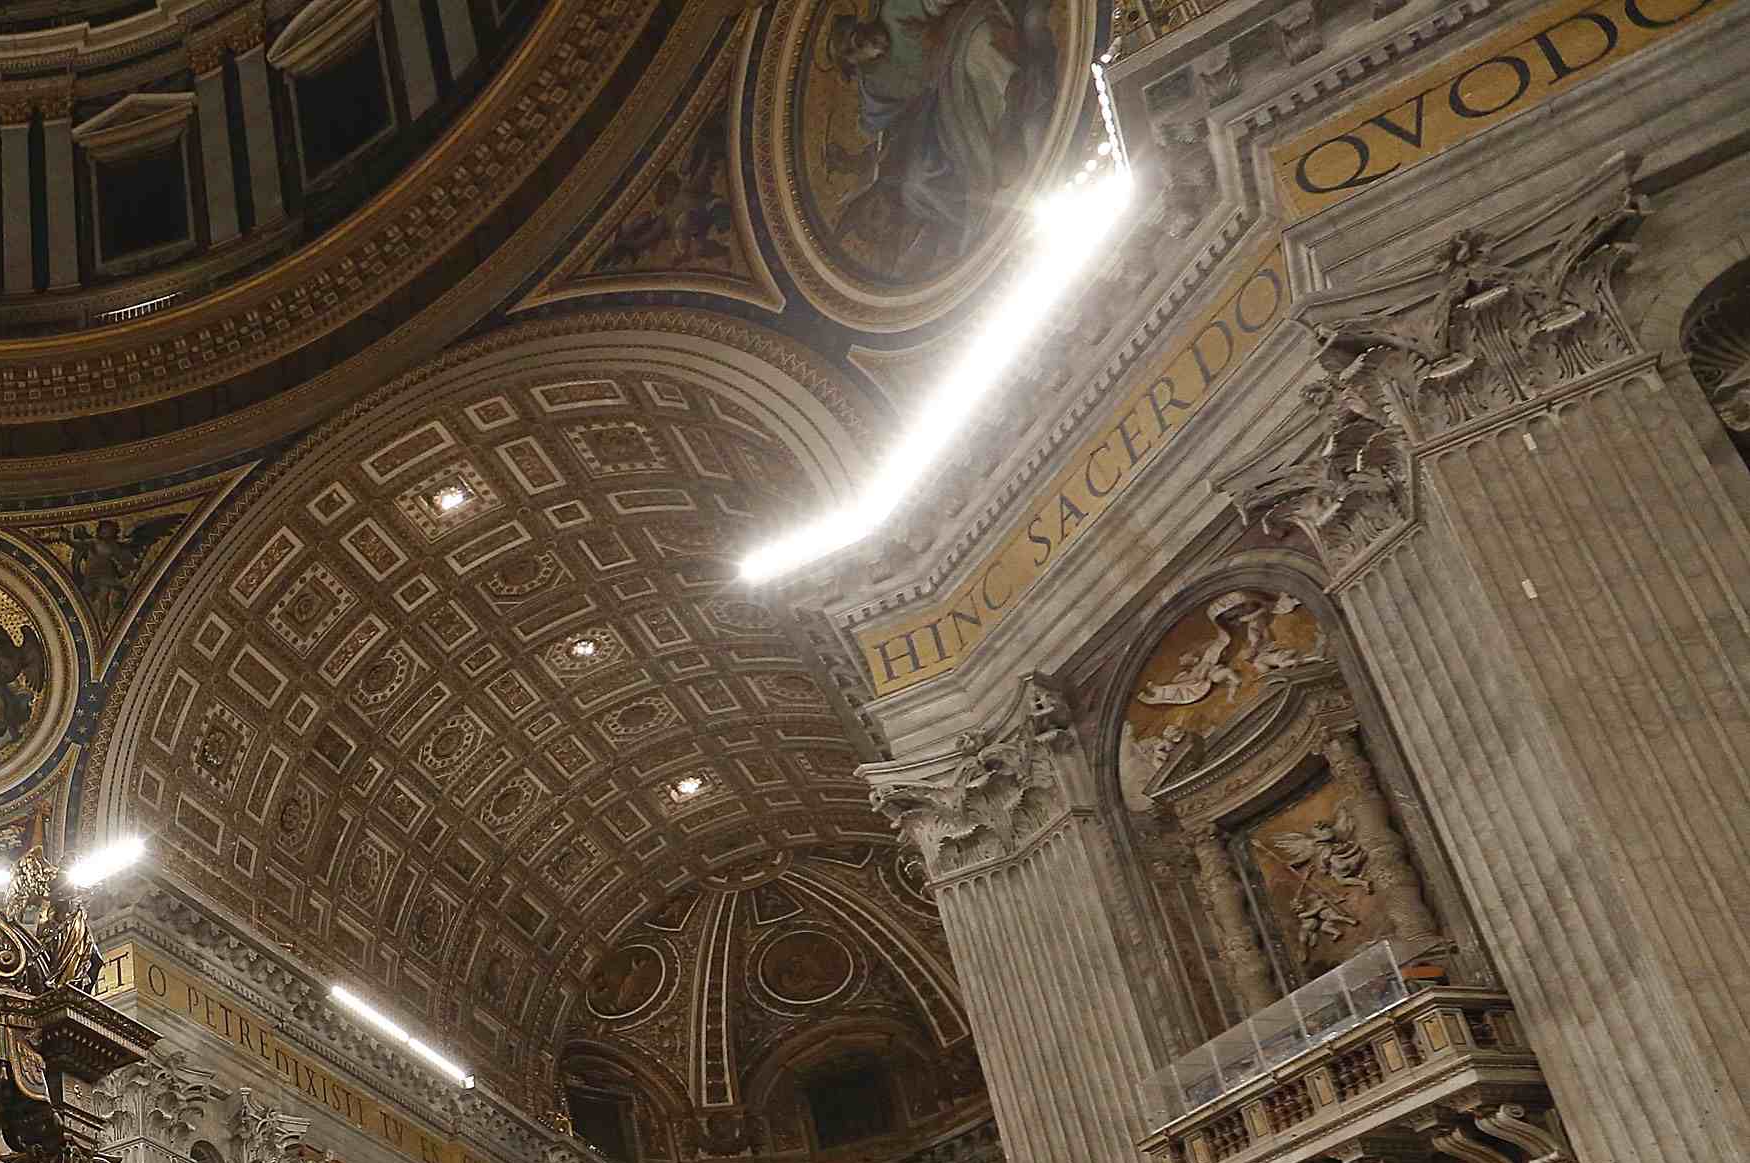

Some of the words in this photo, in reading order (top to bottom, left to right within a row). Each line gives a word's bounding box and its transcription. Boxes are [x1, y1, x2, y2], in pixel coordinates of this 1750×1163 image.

[870, 576, 1019, 686] HINC
[1026, 264, 1290, 568] SACERDO
[148, 964, 167, 997] O
[186, 983, 270, 1060] PETRE
